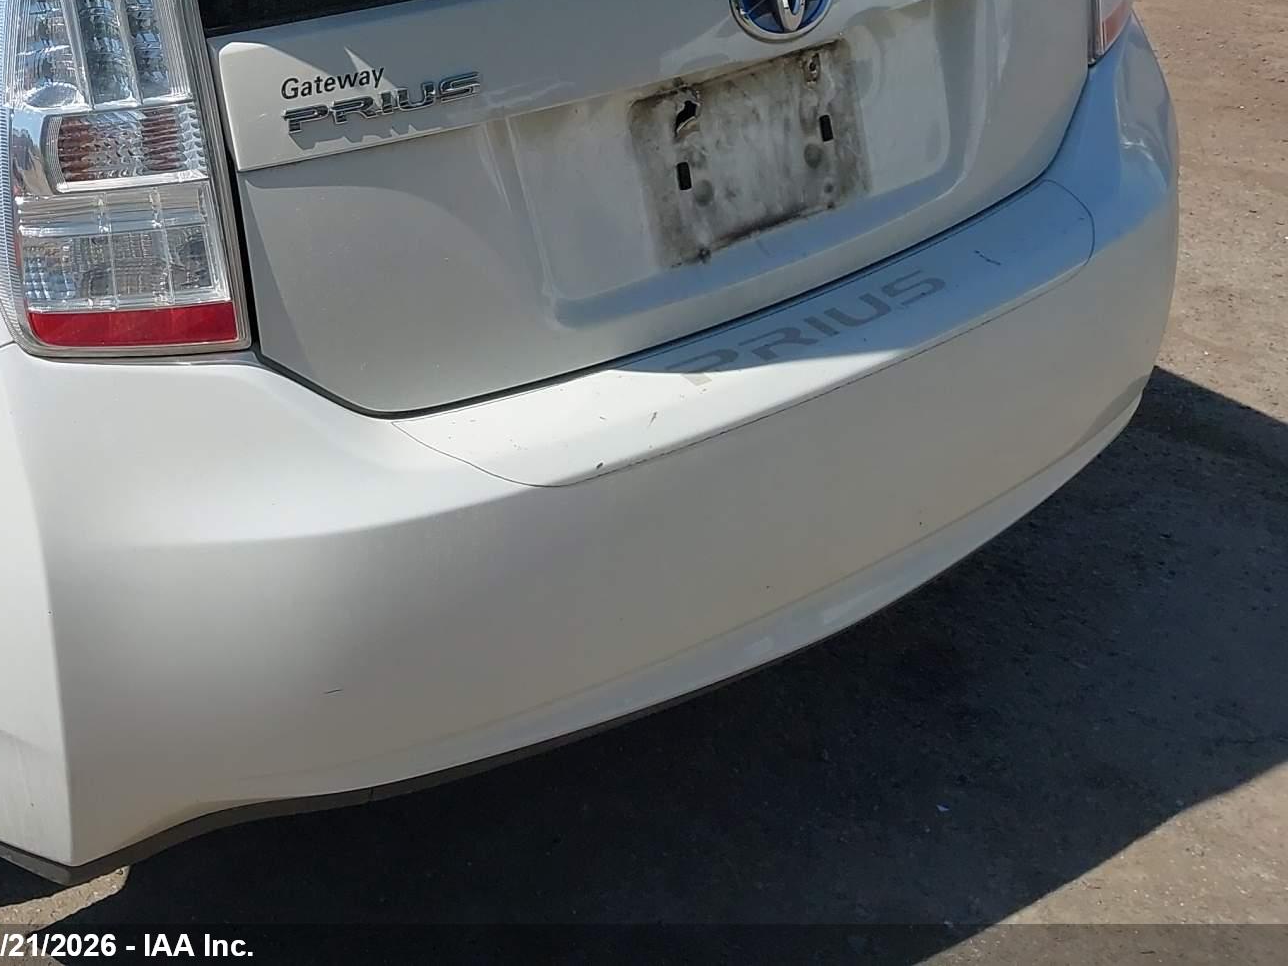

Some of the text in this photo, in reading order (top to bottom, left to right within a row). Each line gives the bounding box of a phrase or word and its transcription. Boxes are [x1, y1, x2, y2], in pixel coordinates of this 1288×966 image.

[281, 67, 384, 100] Gateway
[281, 71, 481, 134] PRIUS
[664, 269, 946, 386] PRIUS
